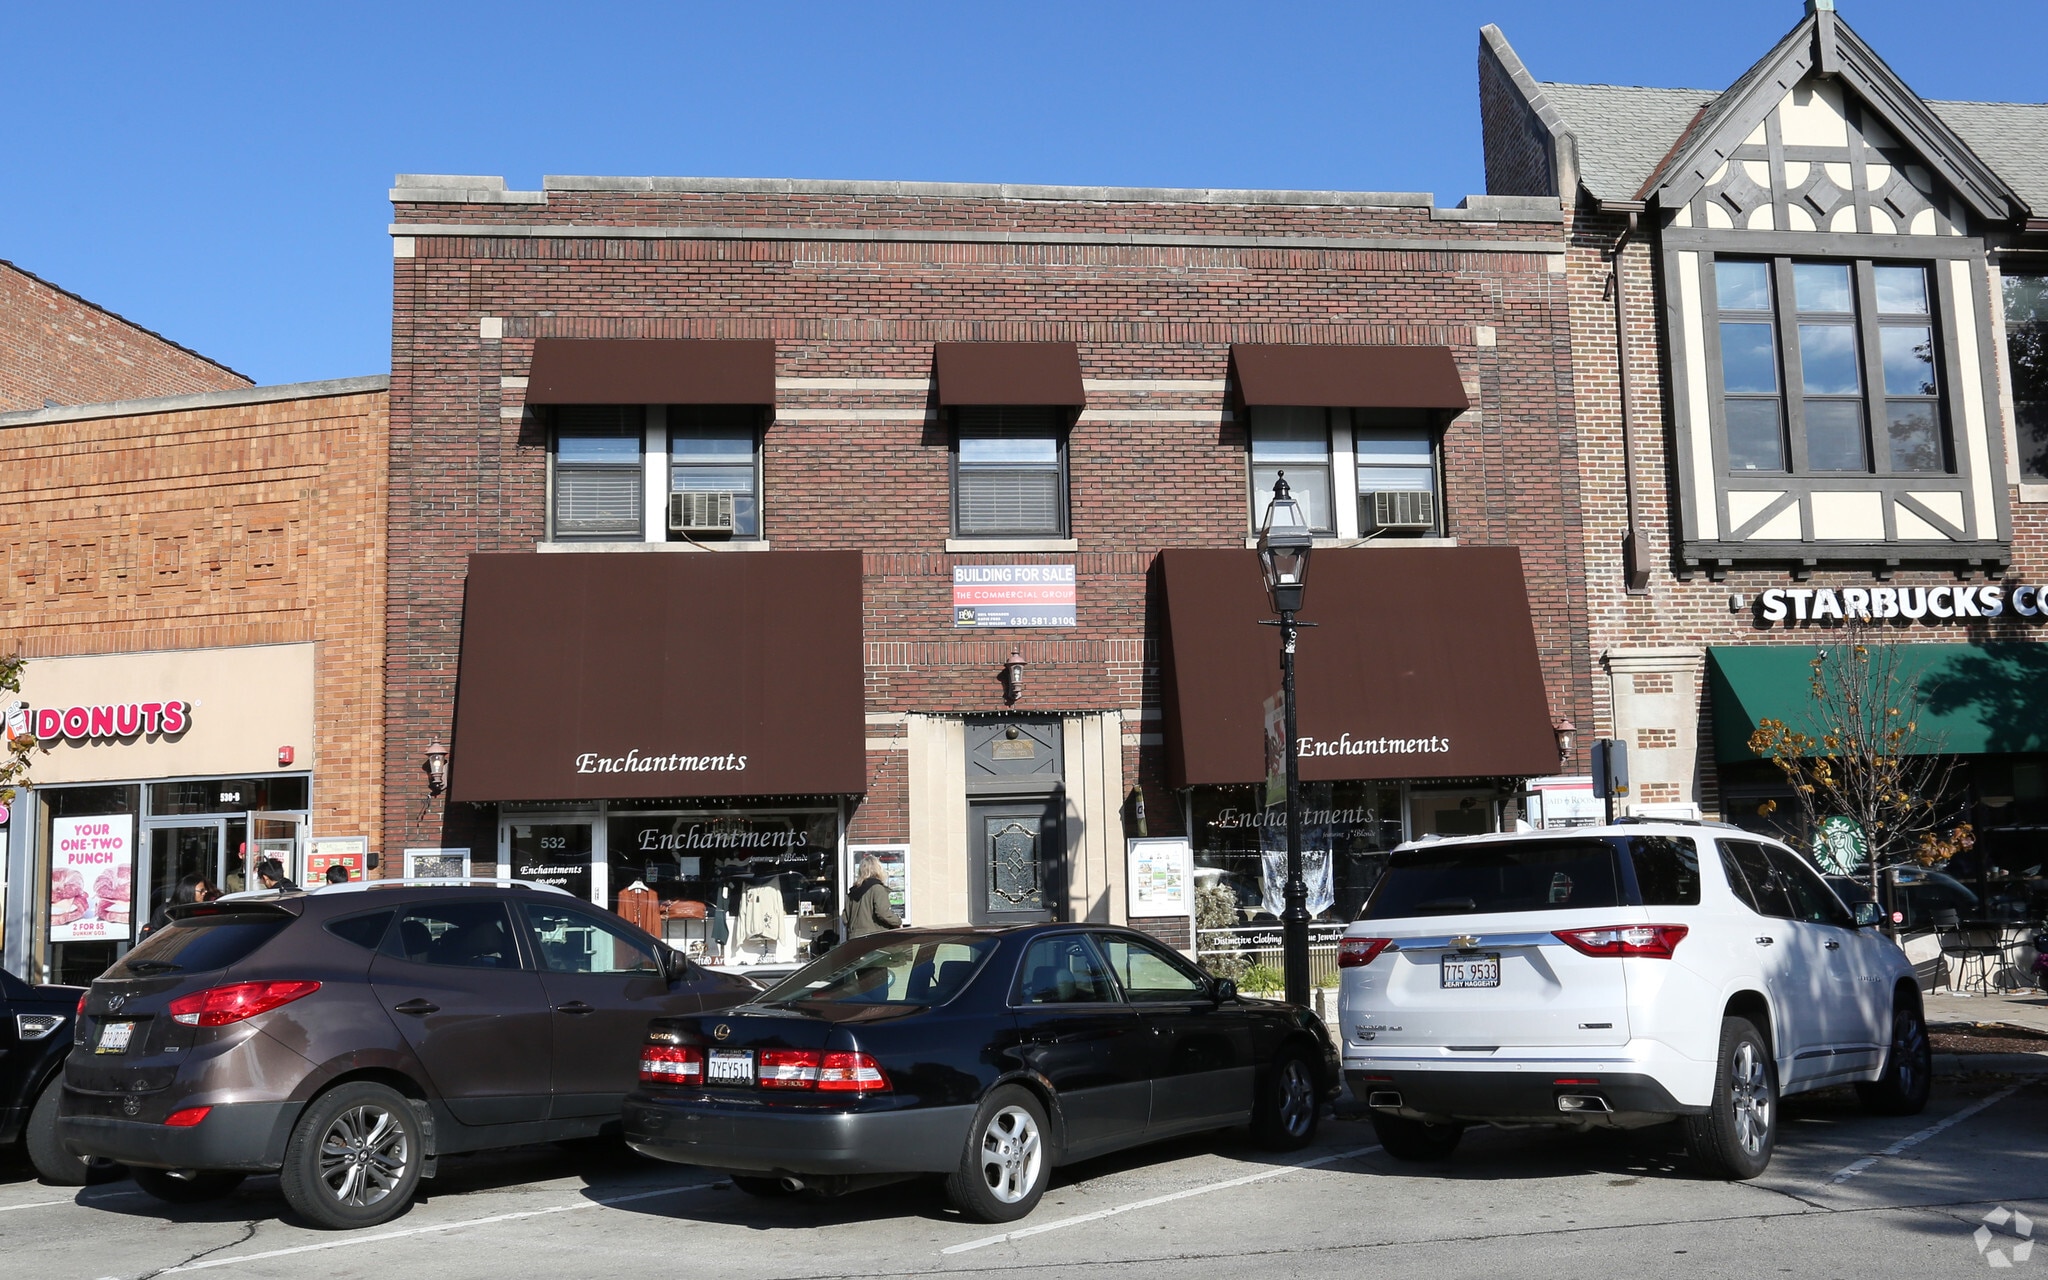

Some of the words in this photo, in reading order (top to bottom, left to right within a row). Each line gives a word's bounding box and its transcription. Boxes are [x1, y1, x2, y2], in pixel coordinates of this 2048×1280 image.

[955, 568, 1012, 582] BUILDING
[1014, 568, 1040, 581] FOR
[1042, 567, 1074, 581] SALE
[956, 591, 972, 599] THE
[974, 591, 1038, 599] COMMERCIAL
[1041, 590, 1074, 598] GROUP
[1763, 586, 2003, 621] STARBUCKS
[37, 700, 185, 739] DONUTS
[1296, 733, 1450, 757] Enchantments
[575, 749, 748, 774] Enchantments
[220, 792, 240, 802] 530-B
[1218, 806, 1375, 829] Enchatments
[74, 824, 110, 836] YOUR
[60, 837, 124, 851] ONE-TWO
[540, 837, 566, 849] 532
[638, 824, 808, 851] Enchantments
[68, 852, 113, 865] PUNCH
[520, 864, 582, 875] Enchantments
[96, 922, 105, 930] $5
[1214, 934, 1251, 946] Distinctive
[1252, 932, 1283, 945] Clothing
[1444, 964, 1464, 980] 775
[1470, 964, 1497, 980] 9533
[711, 1061, 750, 1080] 7YFY511
